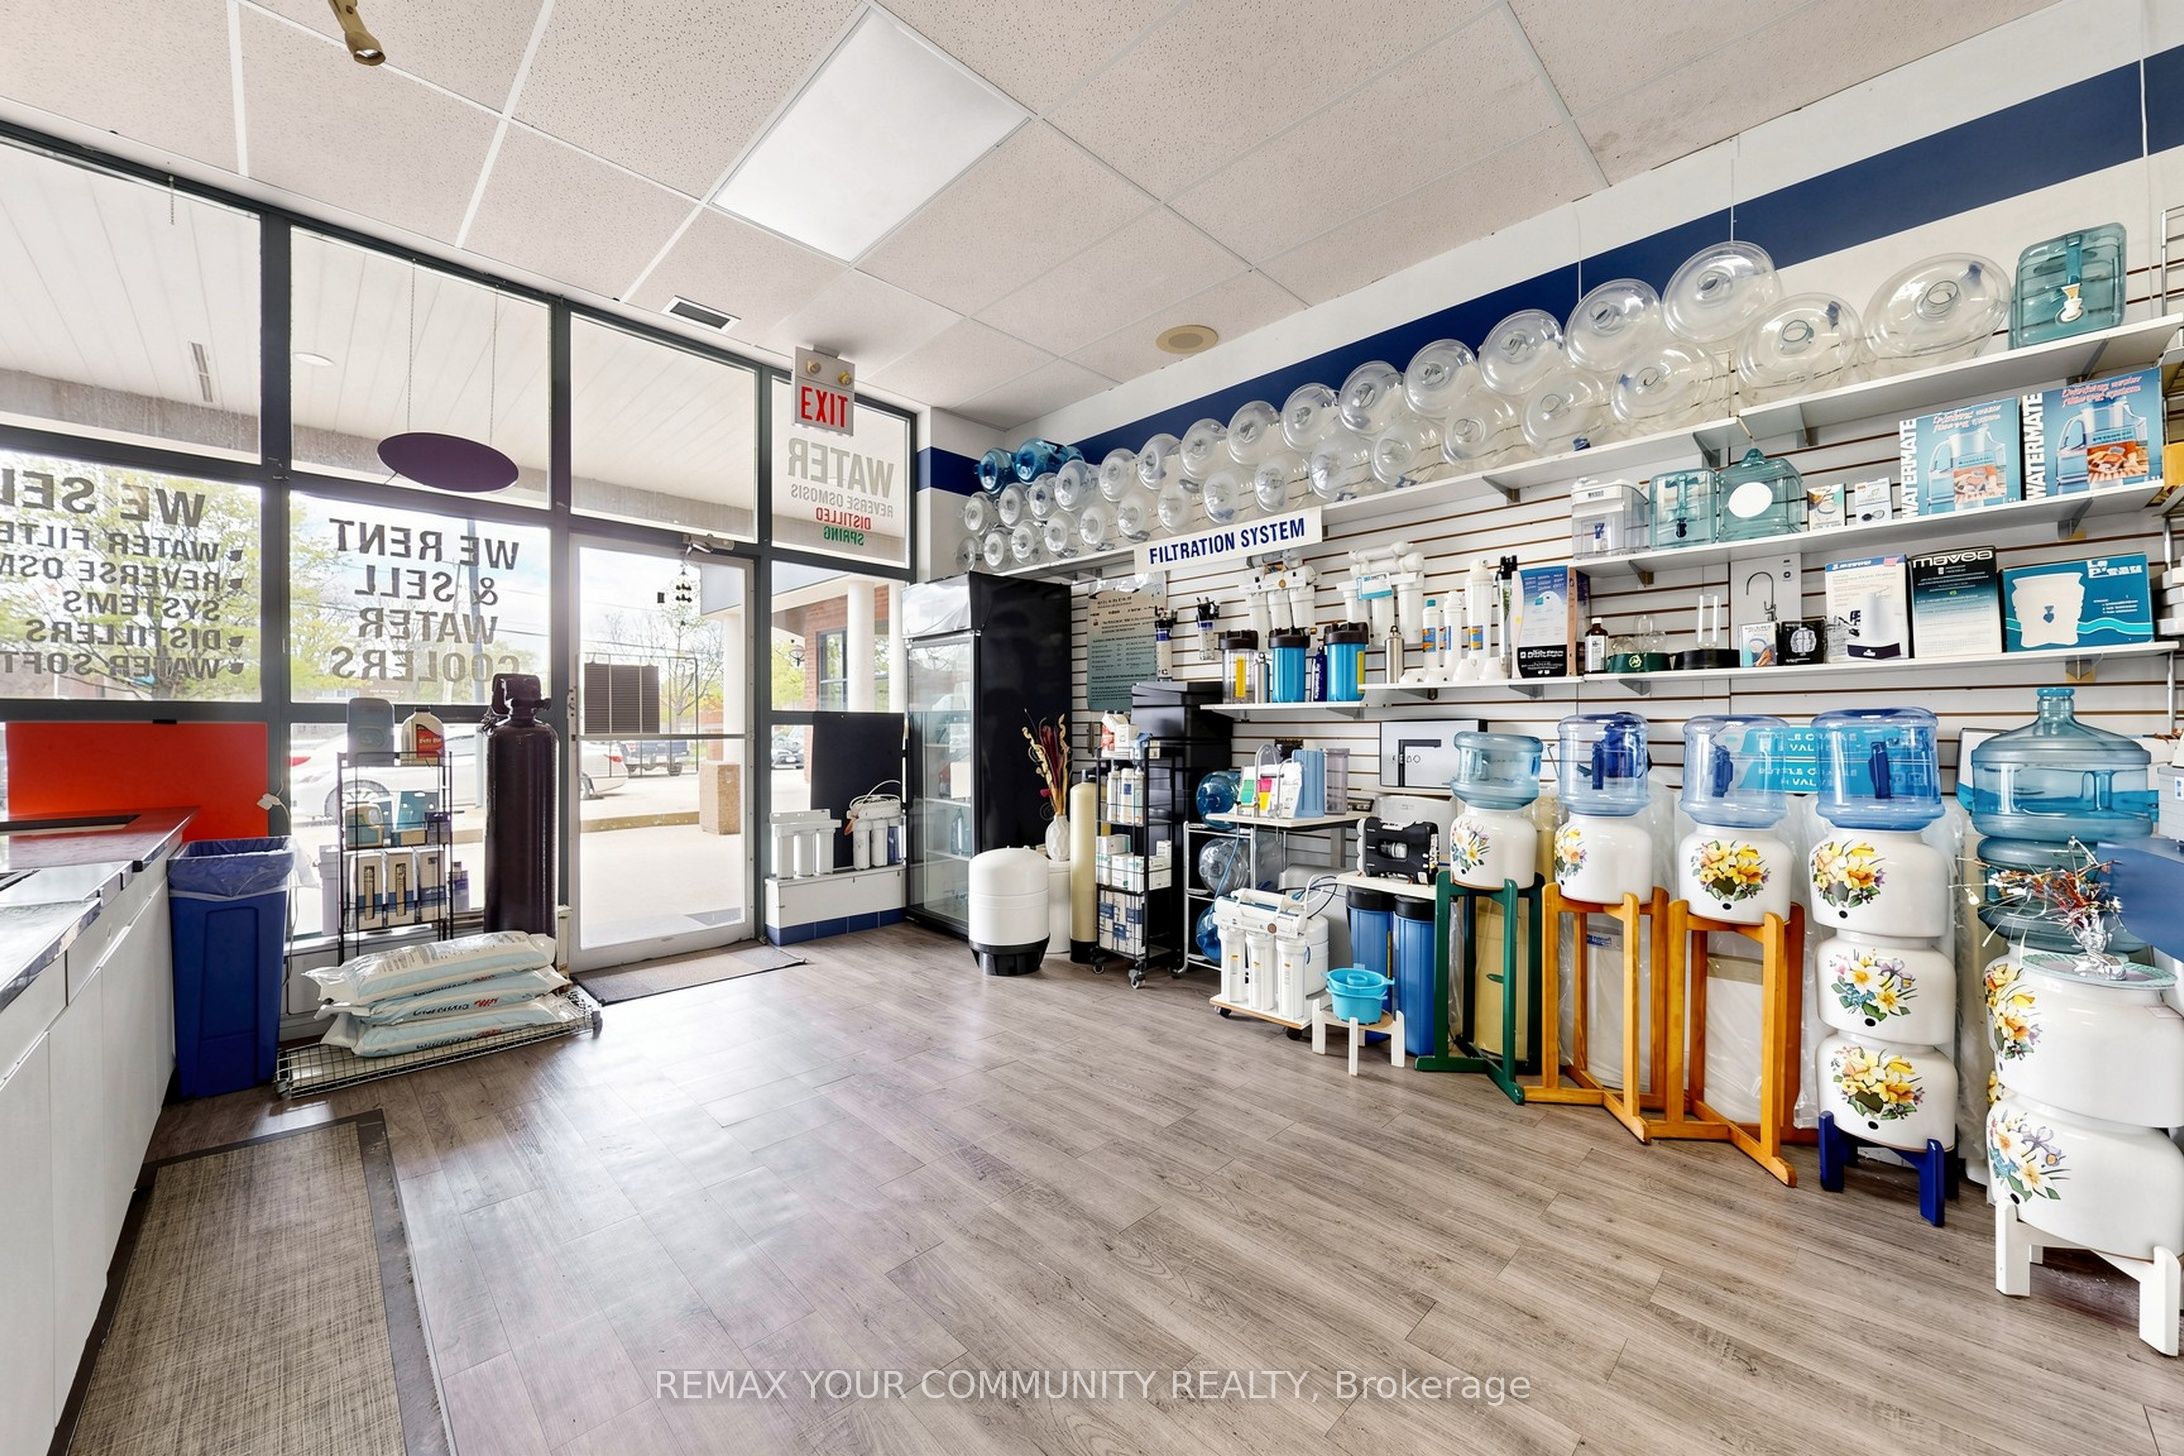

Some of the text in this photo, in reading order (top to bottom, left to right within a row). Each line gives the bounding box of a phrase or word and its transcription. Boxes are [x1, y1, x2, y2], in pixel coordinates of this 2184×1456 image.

[801, 386, 848, 427] EXIT
[1900, 419, 1918, 519] WATERMATE
[2023, 392, 2047, 499] WATERMATE
[1150, 518, 1305, 564] FILTRATION SYSTEM
